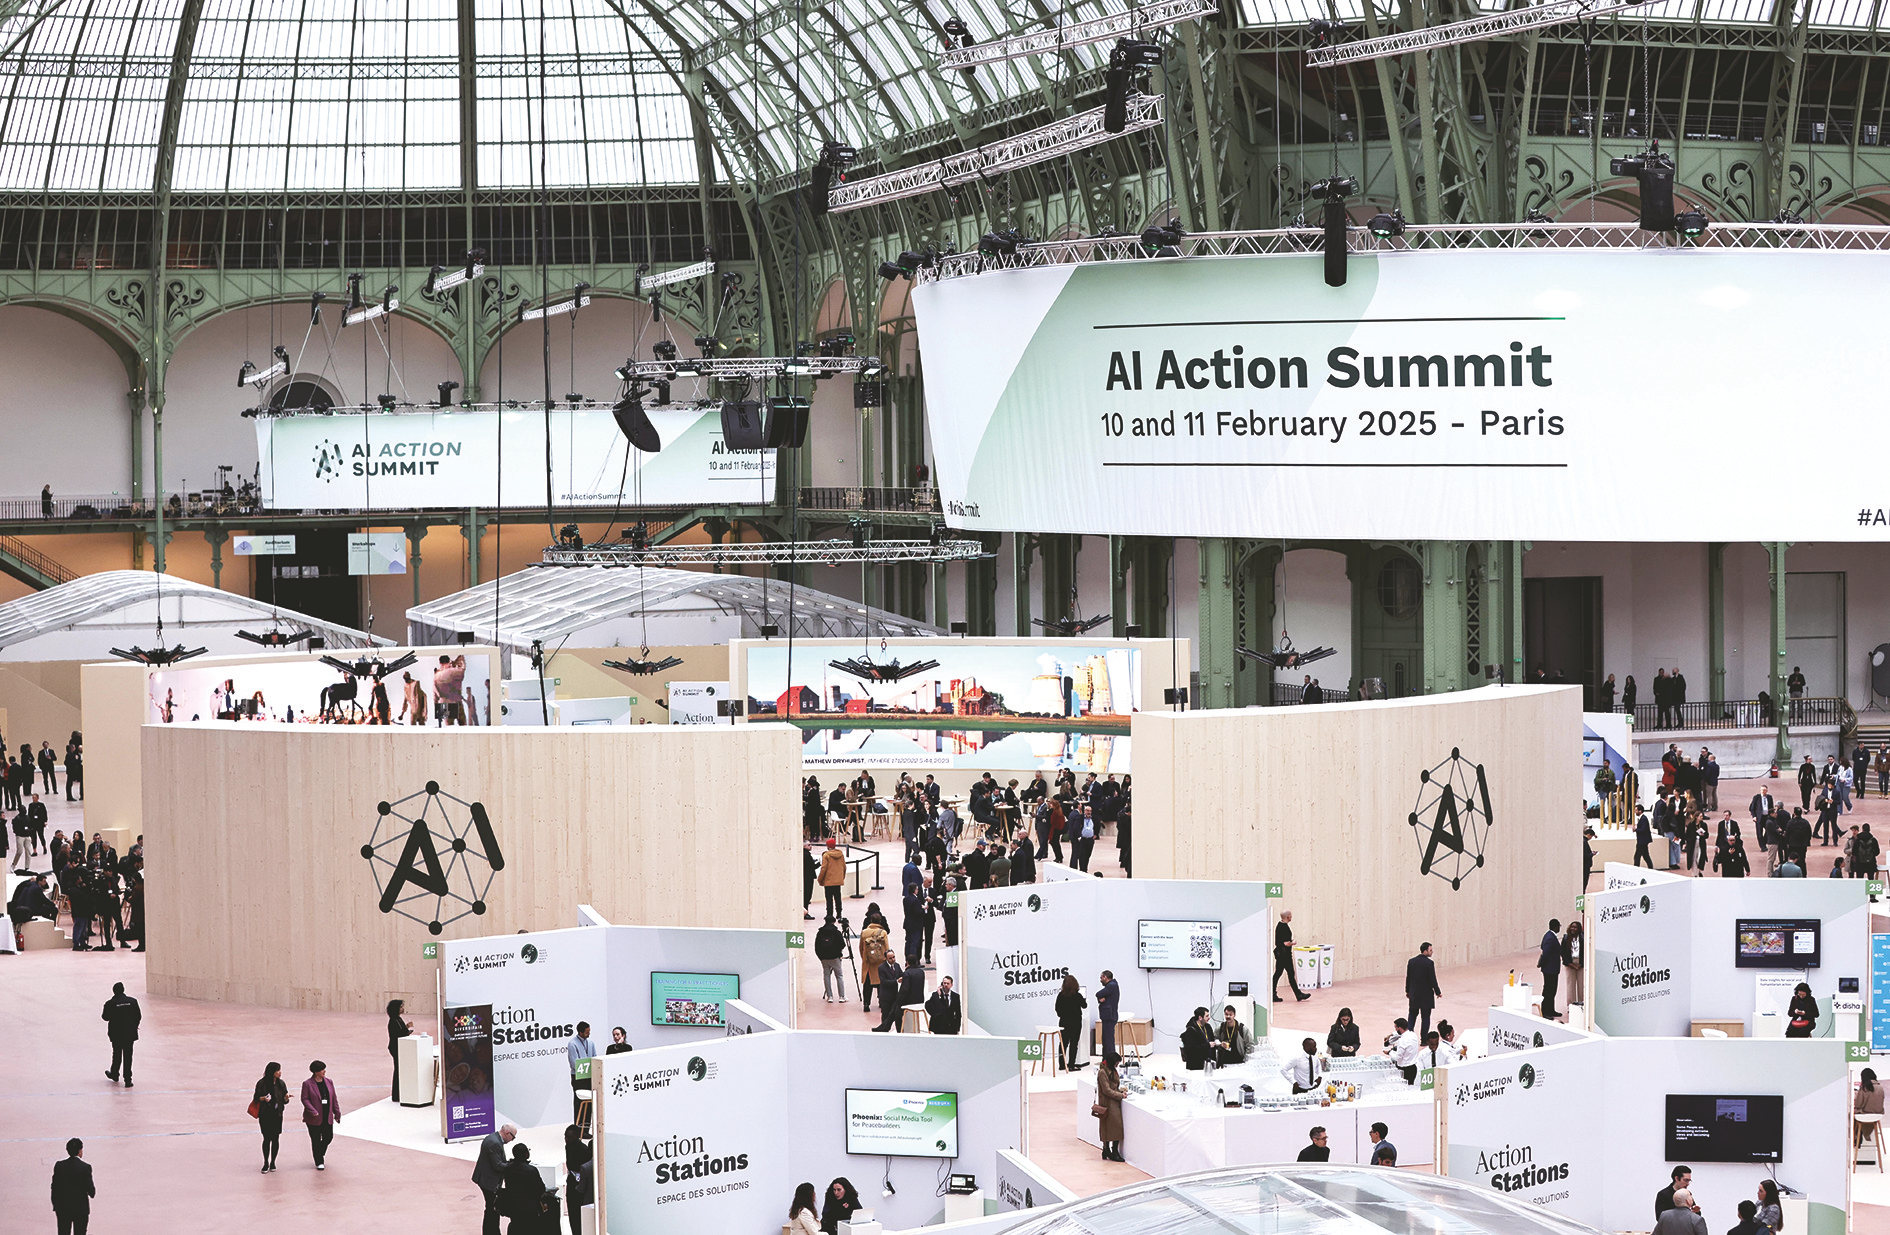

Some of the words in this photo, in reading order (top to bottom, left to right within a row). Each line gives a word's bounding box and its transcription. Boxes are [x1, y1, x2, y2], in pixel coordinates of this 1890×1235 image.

[1106, 350, 1142, 391] AI
[1156, 345, 1308, 390] Action
[1327, 341, 1553, 389] Summit
[1101, 413, 1124, 437] 10
[1132, 410, 1175, 437] and
[1184, 412, 1206, 437] 11
[1217, 409, 1347, 443] February
[1359, 410, 1437, 436] 2025
[1481, 408, 1566, 436] Paris
[352, 443, 371, 458] AI
[379, 442, 462, 457] ACTION
[711, 440, 724, 454] AI
[353, 461, 439, 476] SUMMIT
[709, 461, 718, 470] 10
[719, 461, 732, 470] and
[684, 713, 714, 722] Action
[1270, 886, 1282, 895] 41
[1869, 883, 1882, 892] 28
[947, 894, 958, 904] 43
[1576, 898, 1584, 908] 27
[998, 902, 1023, 910] ACTION
[1618, 903, 1637, 911] ACTION
[989, 909, 1016, 917] SUMMIT
[1612, 911, 1632, 920] SUMMIT
[790, 935, 804, 945] 46
[424, 946, 436, 956] 45
[484, 953, 515, 962] ACTION
[473, 961, 507, 970] SUMMIT
[991, 950, 1039, 970] Action
[1612, 952, 1648, 973] Action
[1004, 966, 1070, 986] Stations
[1621, 968, 1671, 989] Stations
[1005, 992, 1026, 1001] ESPACE
[1027, 991, 1038, 999] DES
[1638, 993, 1647, 1001] DES
[1647, 989, 1671, 999] SOLUTIONS
[1842, 1002, 1861, 1010] disha
[492, 1006, 536, 1026] ction
[492, 1022, 574, 1046] Stations
[1504, 1030, 1509, 1038] AI
[1510, 1032, 1530, 1044] ACTION
[1023, 1044, 1041, 1056] 49
[1504, 1039, 1525, 1051] SUMMIT
[1851, 1045, 1869, 1057] 38
[494, 1051, 520, 1062] ESPACE
[521, 1049, 535, 1059] DES
[536, 1046, 569, 1057] SOLUTION
[576, 1062, 591, 1075] 47
[633, 1074, 643, 1083] AI
[645, 1068, 680, 1080] ACTION
[1421, 1073, 1433, 1085] 40
[633, 1079, 671, 1092] SUMMIT
[1473, 1082, 1482, 1092] AI
[1483, 1075, 1513, 1089] ACTION
[1473, 1087, 1506, 1101] SUMMIT
[637, 1134, 705, 1164] Action
[1475, 1144, 1533, 1174] Action
[655, 1153, 749, 1184] Stations
[1491, 1162, 1570, 1193] Stations
[657, 1192, 686, 1205] ESPACE
[688, 1189, 704, 1199] DES
[706, 1181, 750, 1196] SOLUTIONS
